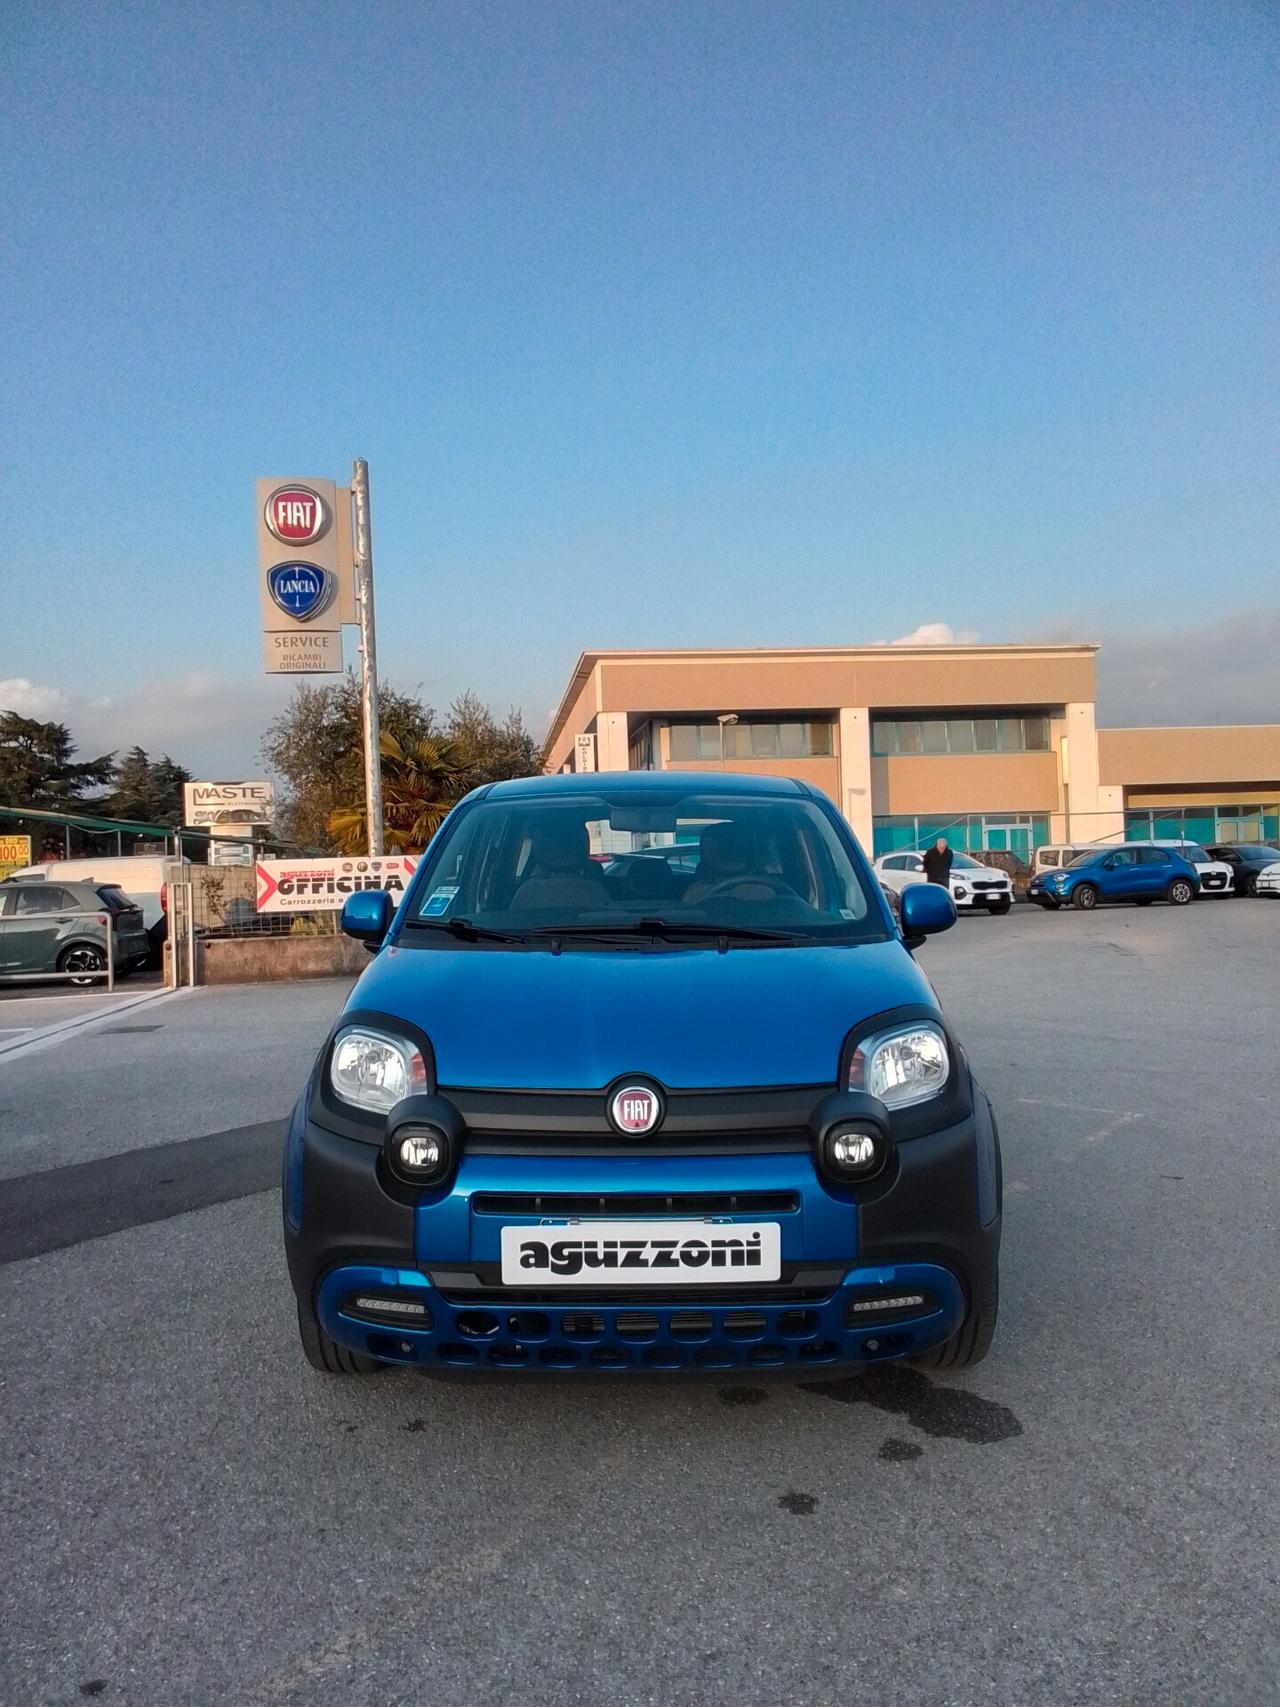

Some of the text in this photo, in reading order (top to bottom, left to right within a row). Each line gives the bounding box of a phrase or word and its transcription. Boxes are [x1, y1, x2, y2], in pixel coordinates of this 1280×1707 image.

[277, 501, 314, 529] FIAT
[280, 579, 315, 594] LANCIA
[274, 636, 329, 648] SERVICE
[282, 653, 322, 661] RICAMBI
[279, 661, 326, 670] ORIGINALI
[277, 874, 404, 896] OFFICINA
[279, 896, 335, 906] Carrozzeria
[623, 1100, 650, 1121] FIAT
[519, 1231, 762, 1276] aguzzoni
